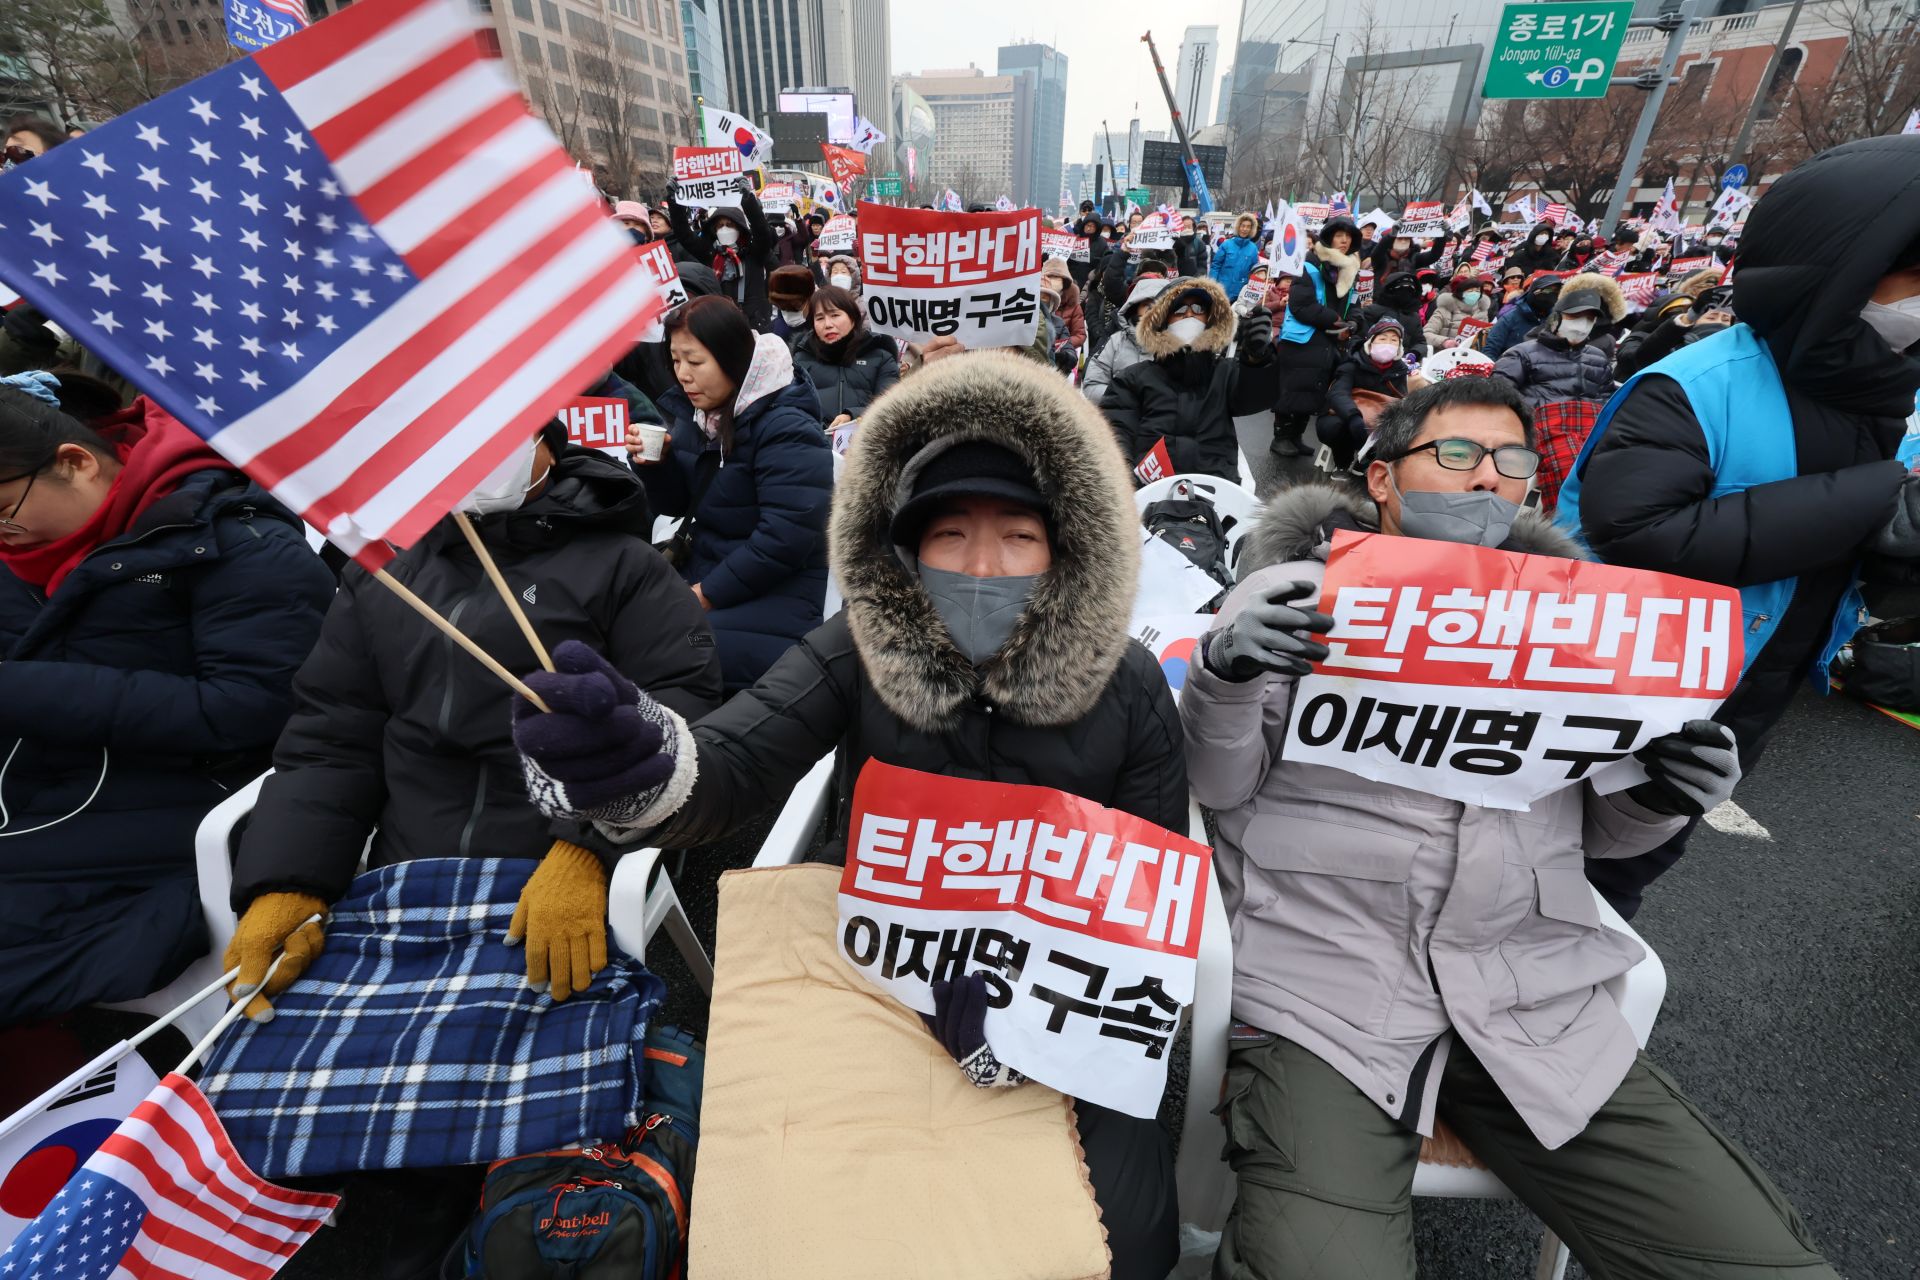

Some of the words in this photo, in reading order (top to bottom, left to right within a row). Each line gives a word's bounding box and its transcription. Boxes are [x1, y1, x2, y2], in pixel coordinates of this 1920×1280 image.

[1508, 11, 1616, 42] 종로1가
[1500, 46, 1541, 64] Jongno
[1544, 44, 1581, 63] 1(il)-ga
[1550, 69, 1563, 85] 6
[674, 150, 740, 179] 탄핵반대
[676, 181, 716, 201] 이재명
[863, 217, 1038, 284] 탄핵반대
[868, 297, 961, 337] 이재명
[964, 287, 1037, 329] 구속
[1322, 586, 1731, 691] 탄핵반대
[1297, 693, 1542, 777] 이재명
[854, 812, 1201, 947] 탄핵반대
[843, 915, 1031, 1010] 이재명
[1028, 949, 1181, 1060] 구속
